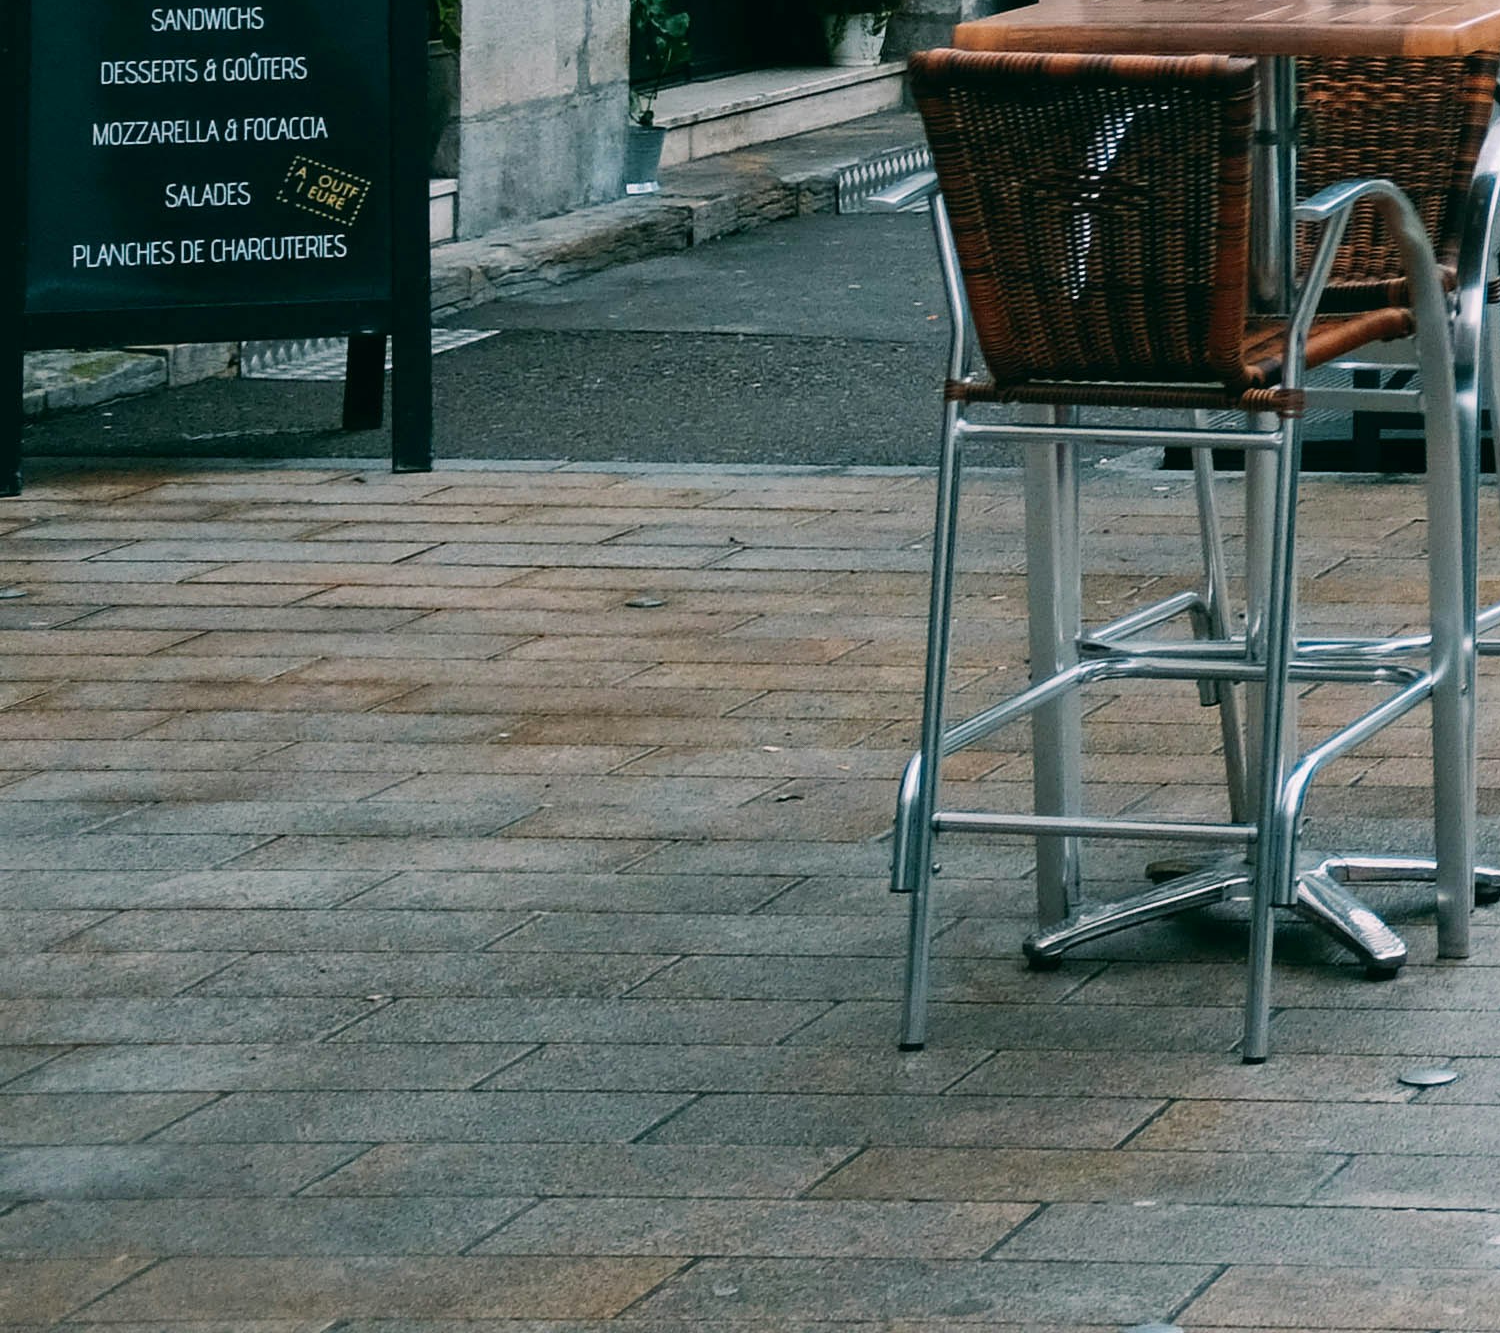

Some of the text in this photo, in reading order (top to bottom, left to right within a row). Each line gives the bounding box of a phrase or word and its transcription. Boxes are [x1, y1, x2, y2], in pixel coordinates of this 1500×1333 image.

[150, 6, 265, 32] SANDWICHS
[100, 52, 308, 85] DESSERTS & GOÛTERS
[92, 116, 329, 146] MOZZARELLA & FOCACCIA
[164, 181, 252, 208] SALADES
[72, 233, 348, 269] PLANCHES DE CHARCUTERIES
